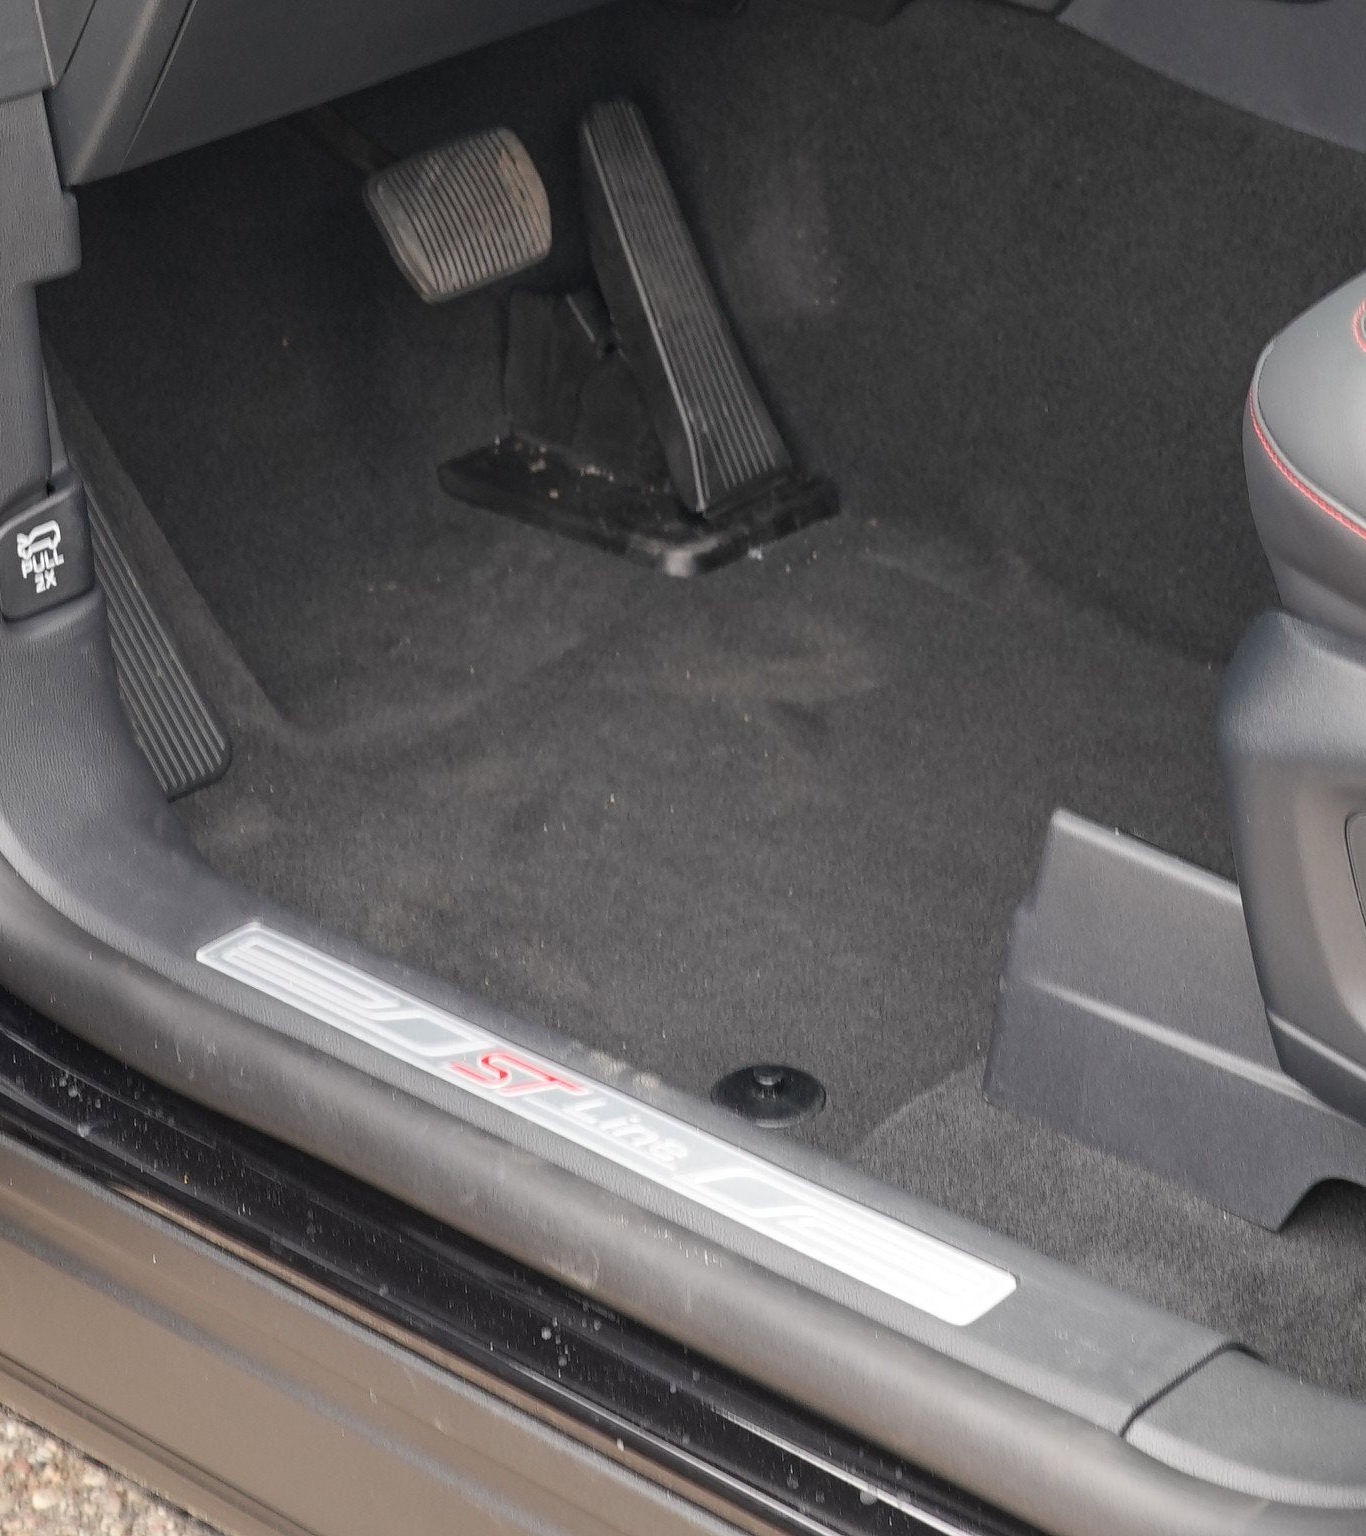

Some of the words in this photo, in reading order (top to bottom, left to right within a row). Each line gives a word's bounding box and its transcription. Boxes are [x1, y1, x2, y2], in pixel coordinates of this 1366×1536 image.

[21, 549, 65, 579] PULL
[35, 567, 57, 594] 2X
[449, 1052, 588, 1096] ST
